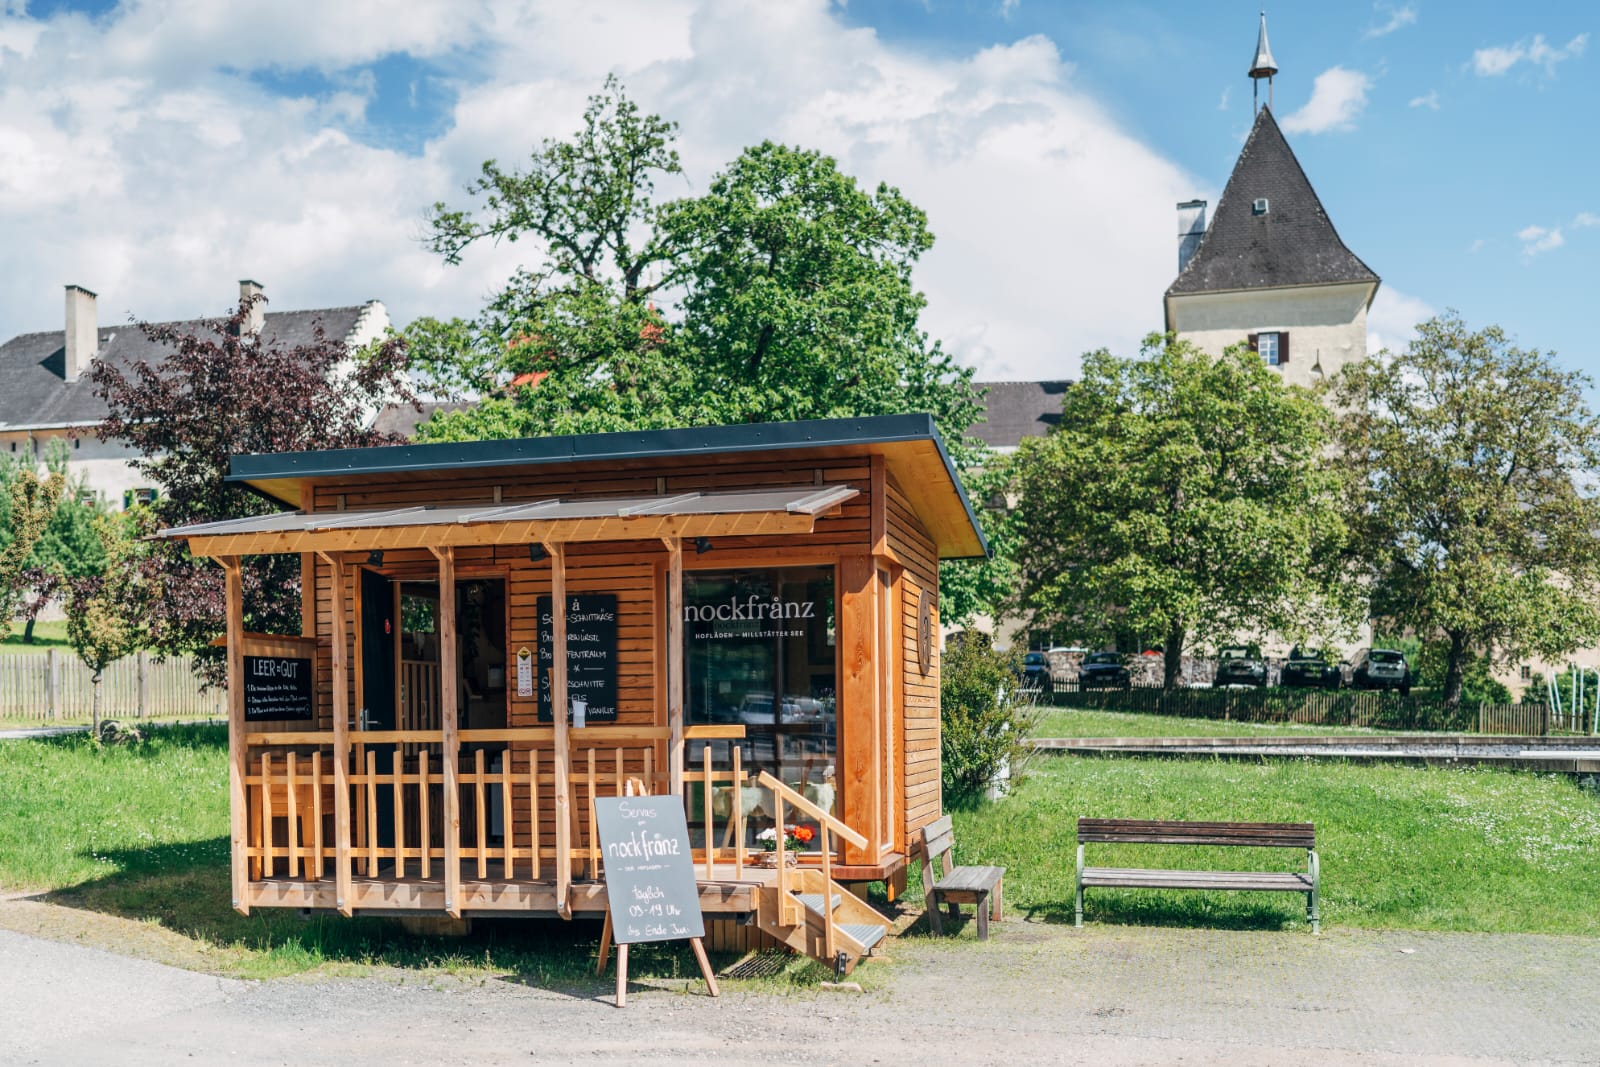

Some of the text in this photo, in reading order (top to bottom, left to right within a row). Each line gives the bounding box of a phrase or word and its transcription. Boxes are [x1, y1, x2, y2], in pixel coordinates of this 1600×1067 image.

[684, 594, 815, 622] nockfrånz
[790, 629, 804, 637] SEE
[666, 903, 681, 916] Uhr
[645, 924, 667, 937] Ende
